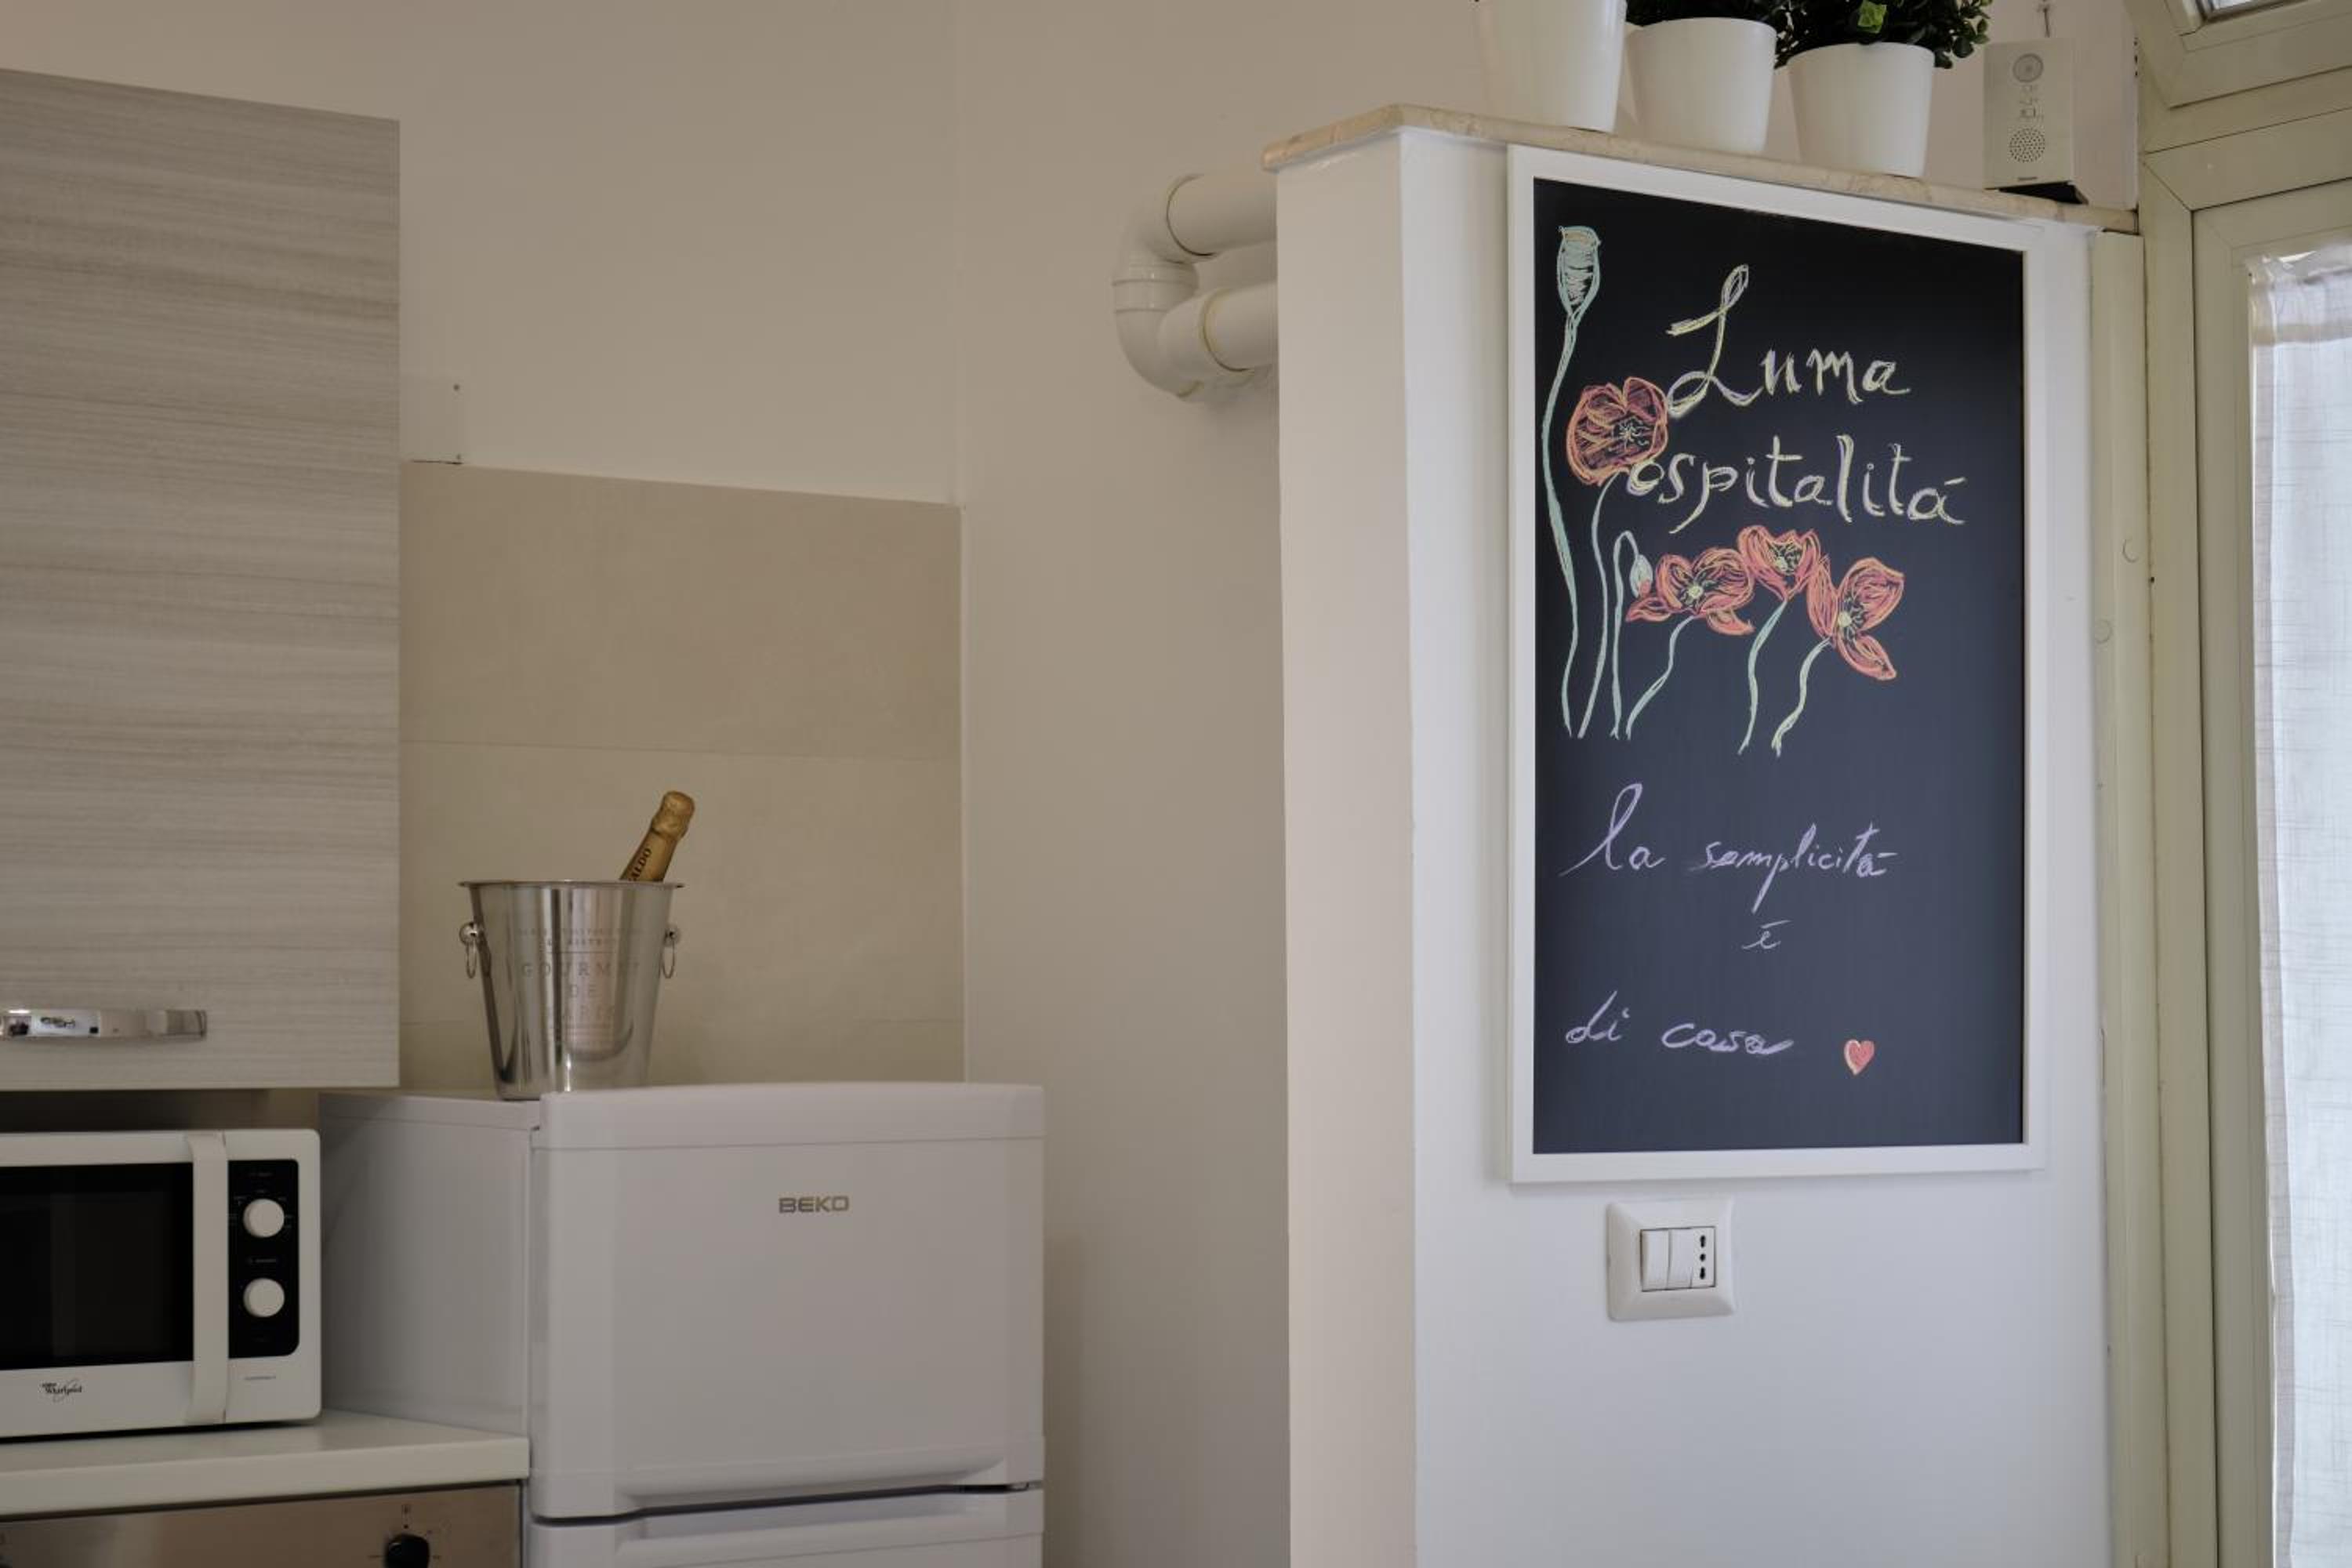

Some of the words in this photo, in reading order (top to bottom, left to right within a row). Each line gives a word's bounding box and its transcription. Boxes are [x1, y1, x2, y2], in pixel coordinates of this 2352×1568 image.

[1665, 263, 1911, 419] Luma
[1559, 782, 1665, 877] la
[1565, 990, 1631, 1044] di
[1661, 1023, 1795, 1055] casa
[779, 1196, 849, 1214] BEKO
